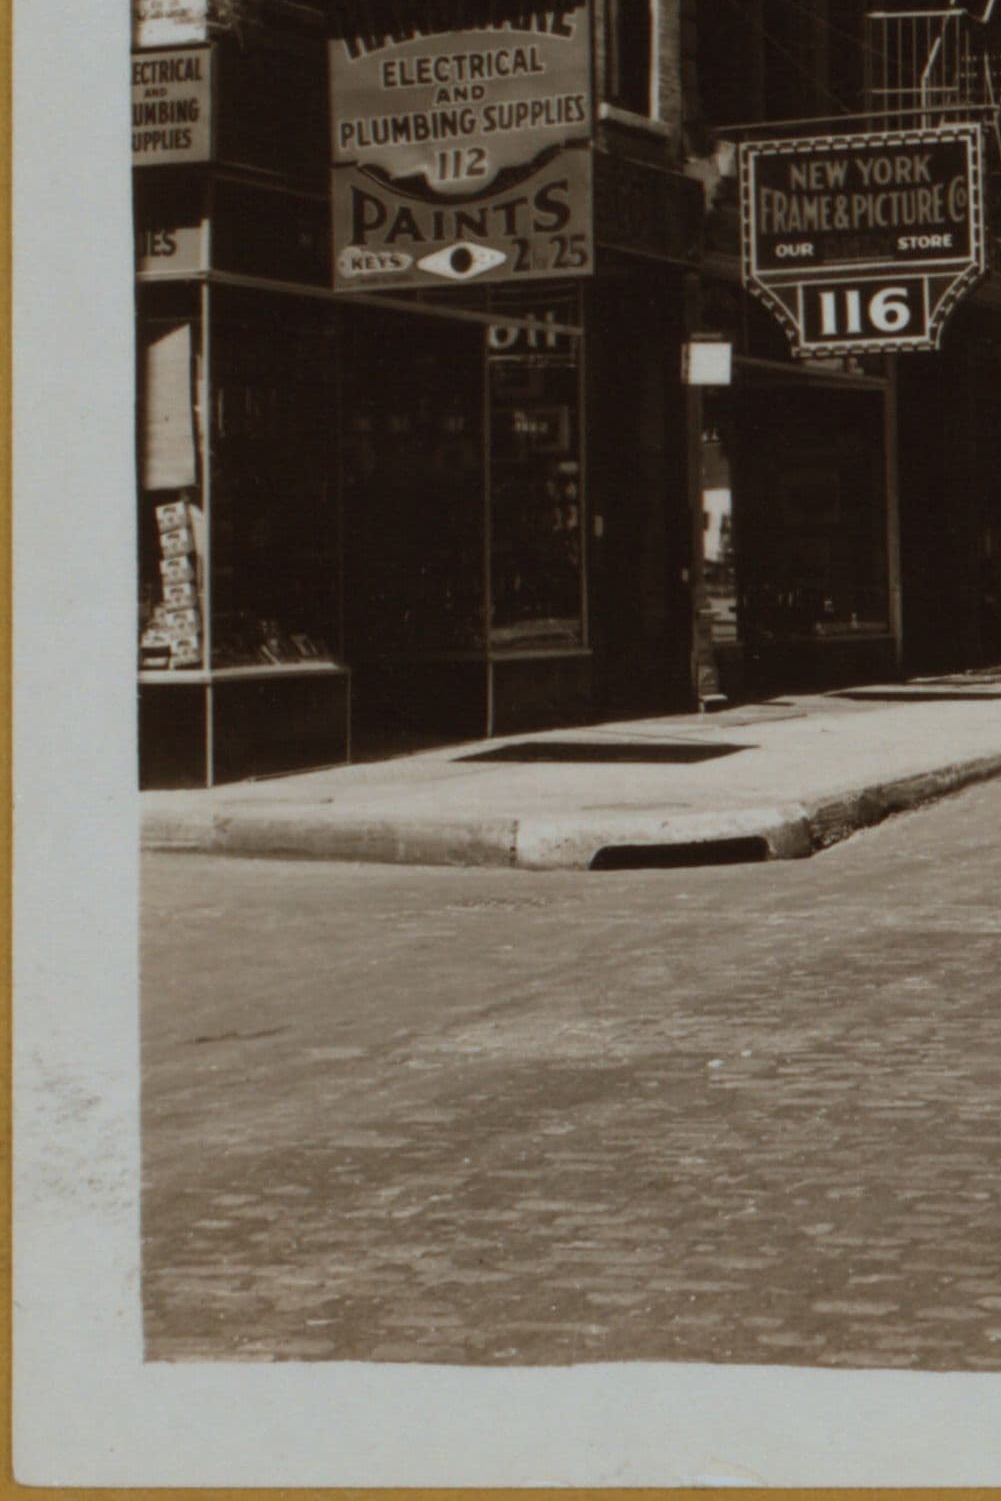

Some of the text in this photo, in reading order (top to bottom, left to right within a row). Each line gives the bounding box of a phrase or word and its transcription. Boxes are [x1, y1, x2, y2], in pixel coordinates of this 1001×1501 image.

[133, 57, 203, 85] ECTRICAL
[382, 47, 545, 89] ELECTRICAL
[143, 87, 168, 98] AND
[435, 84, 486, 105] AND
[339, 94, 587, 149] PLUMBING SUPPLIES
[436, 147, 487, 181] 112
[789, 154, 932, 190] NEW YORK
[351, 178, 571, 246] PAINTS
[350, 252, 401, 272] KEYS
[511, 236, 532, 274] 2
[549, 232, 589, 270] 25
[775, 242, 815, 258] OUR
[897, 233, 953, 250] STORE
[818, 286, 912, 336] 116
